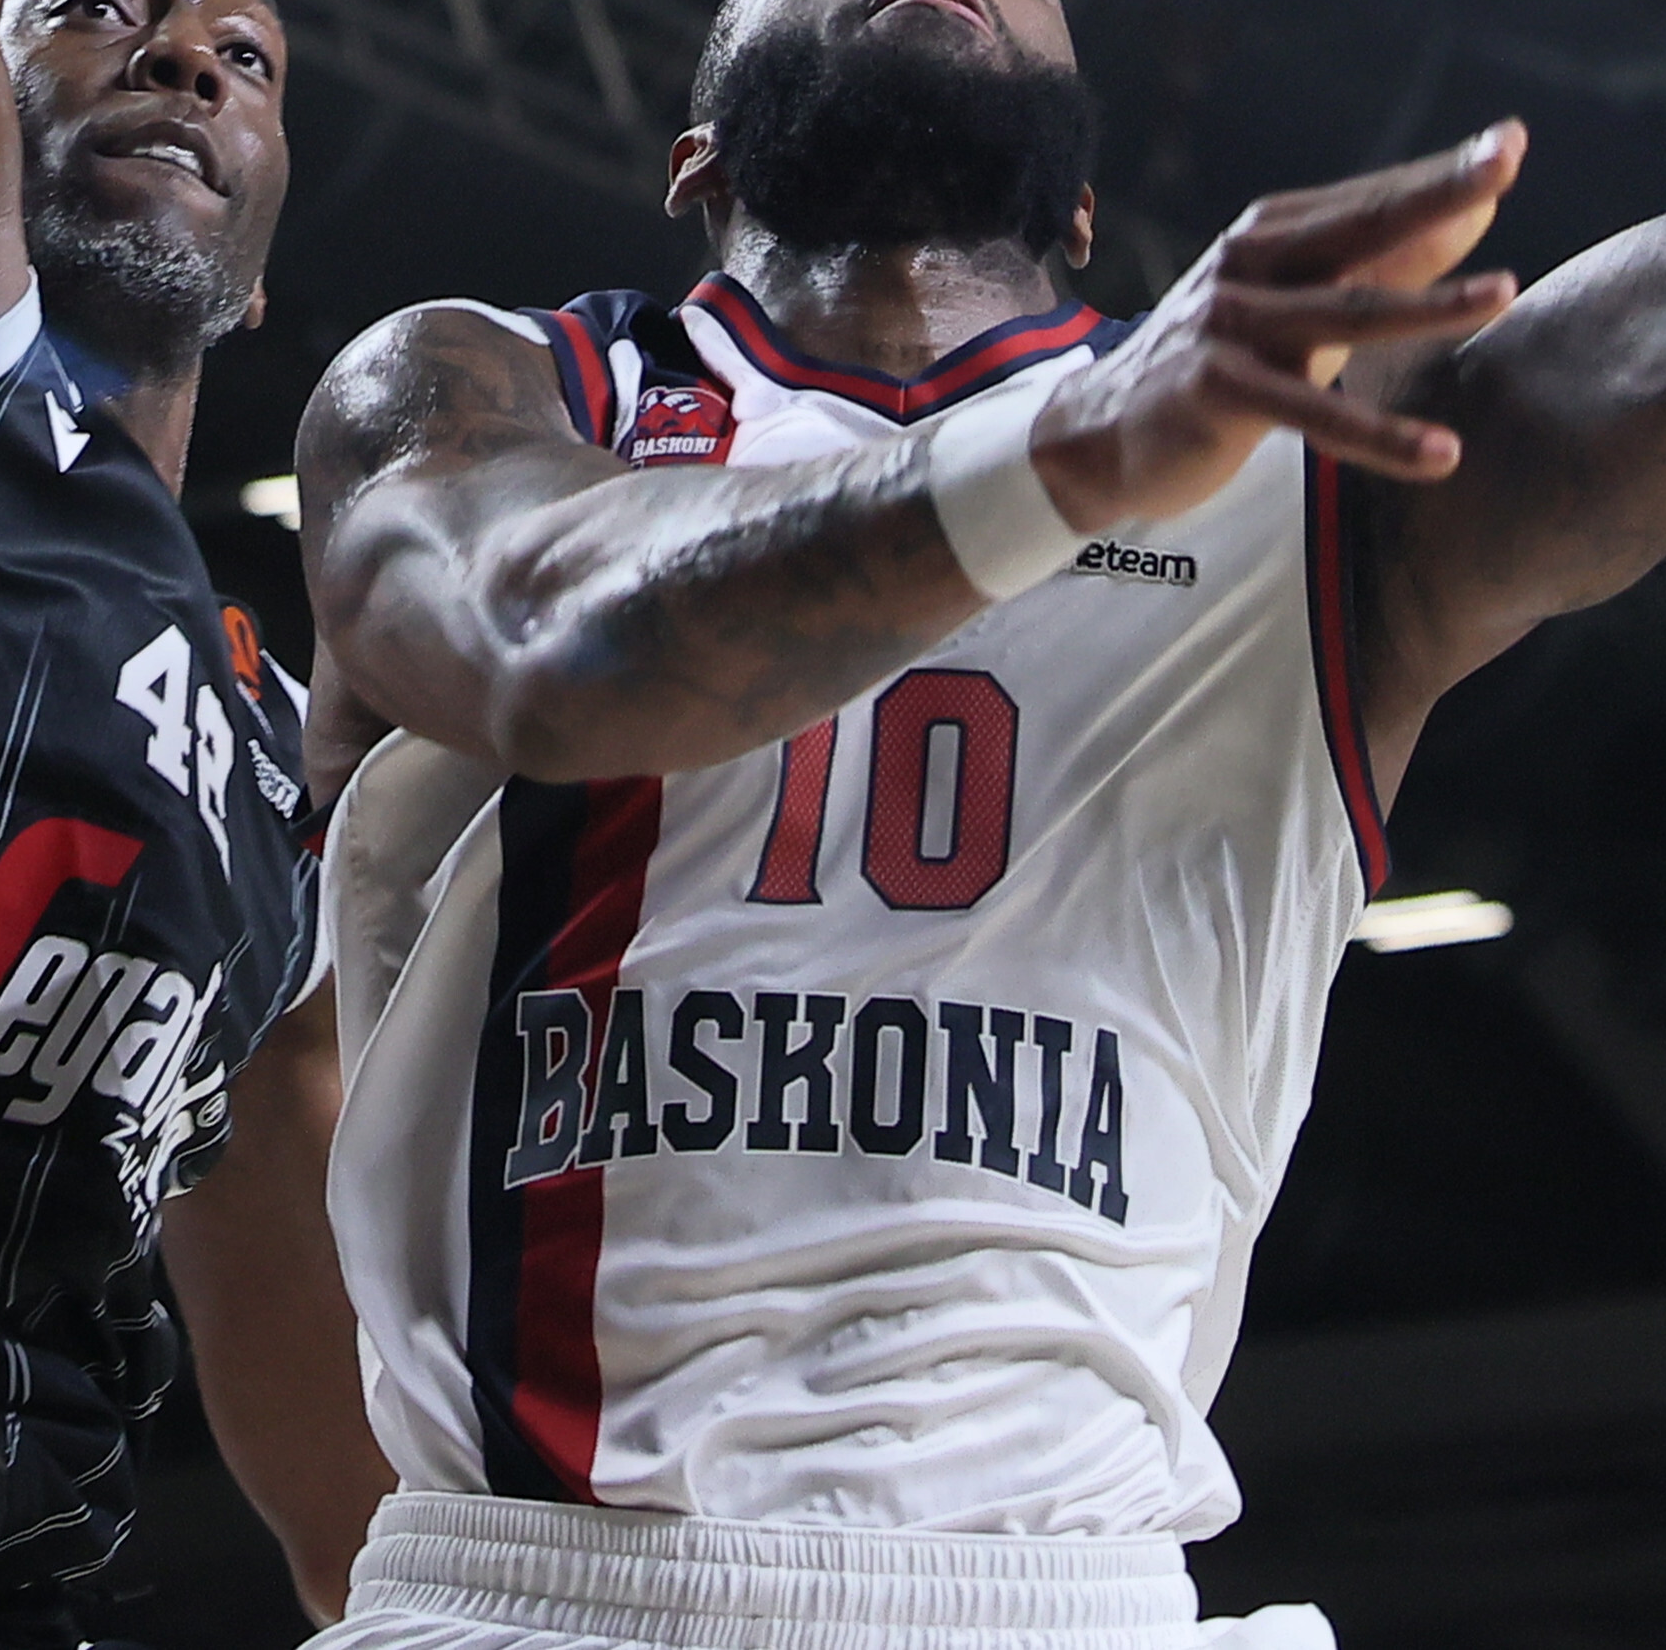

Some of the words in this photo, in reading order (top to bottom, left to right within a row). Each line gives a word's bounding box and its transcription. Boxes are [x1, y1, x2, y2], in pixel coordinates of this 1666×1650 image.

[1075, 540, 1196, 581] eteam
[745, 667, 1020, 910] 10
[504, 986, 1131, 1227] BASKONIA
